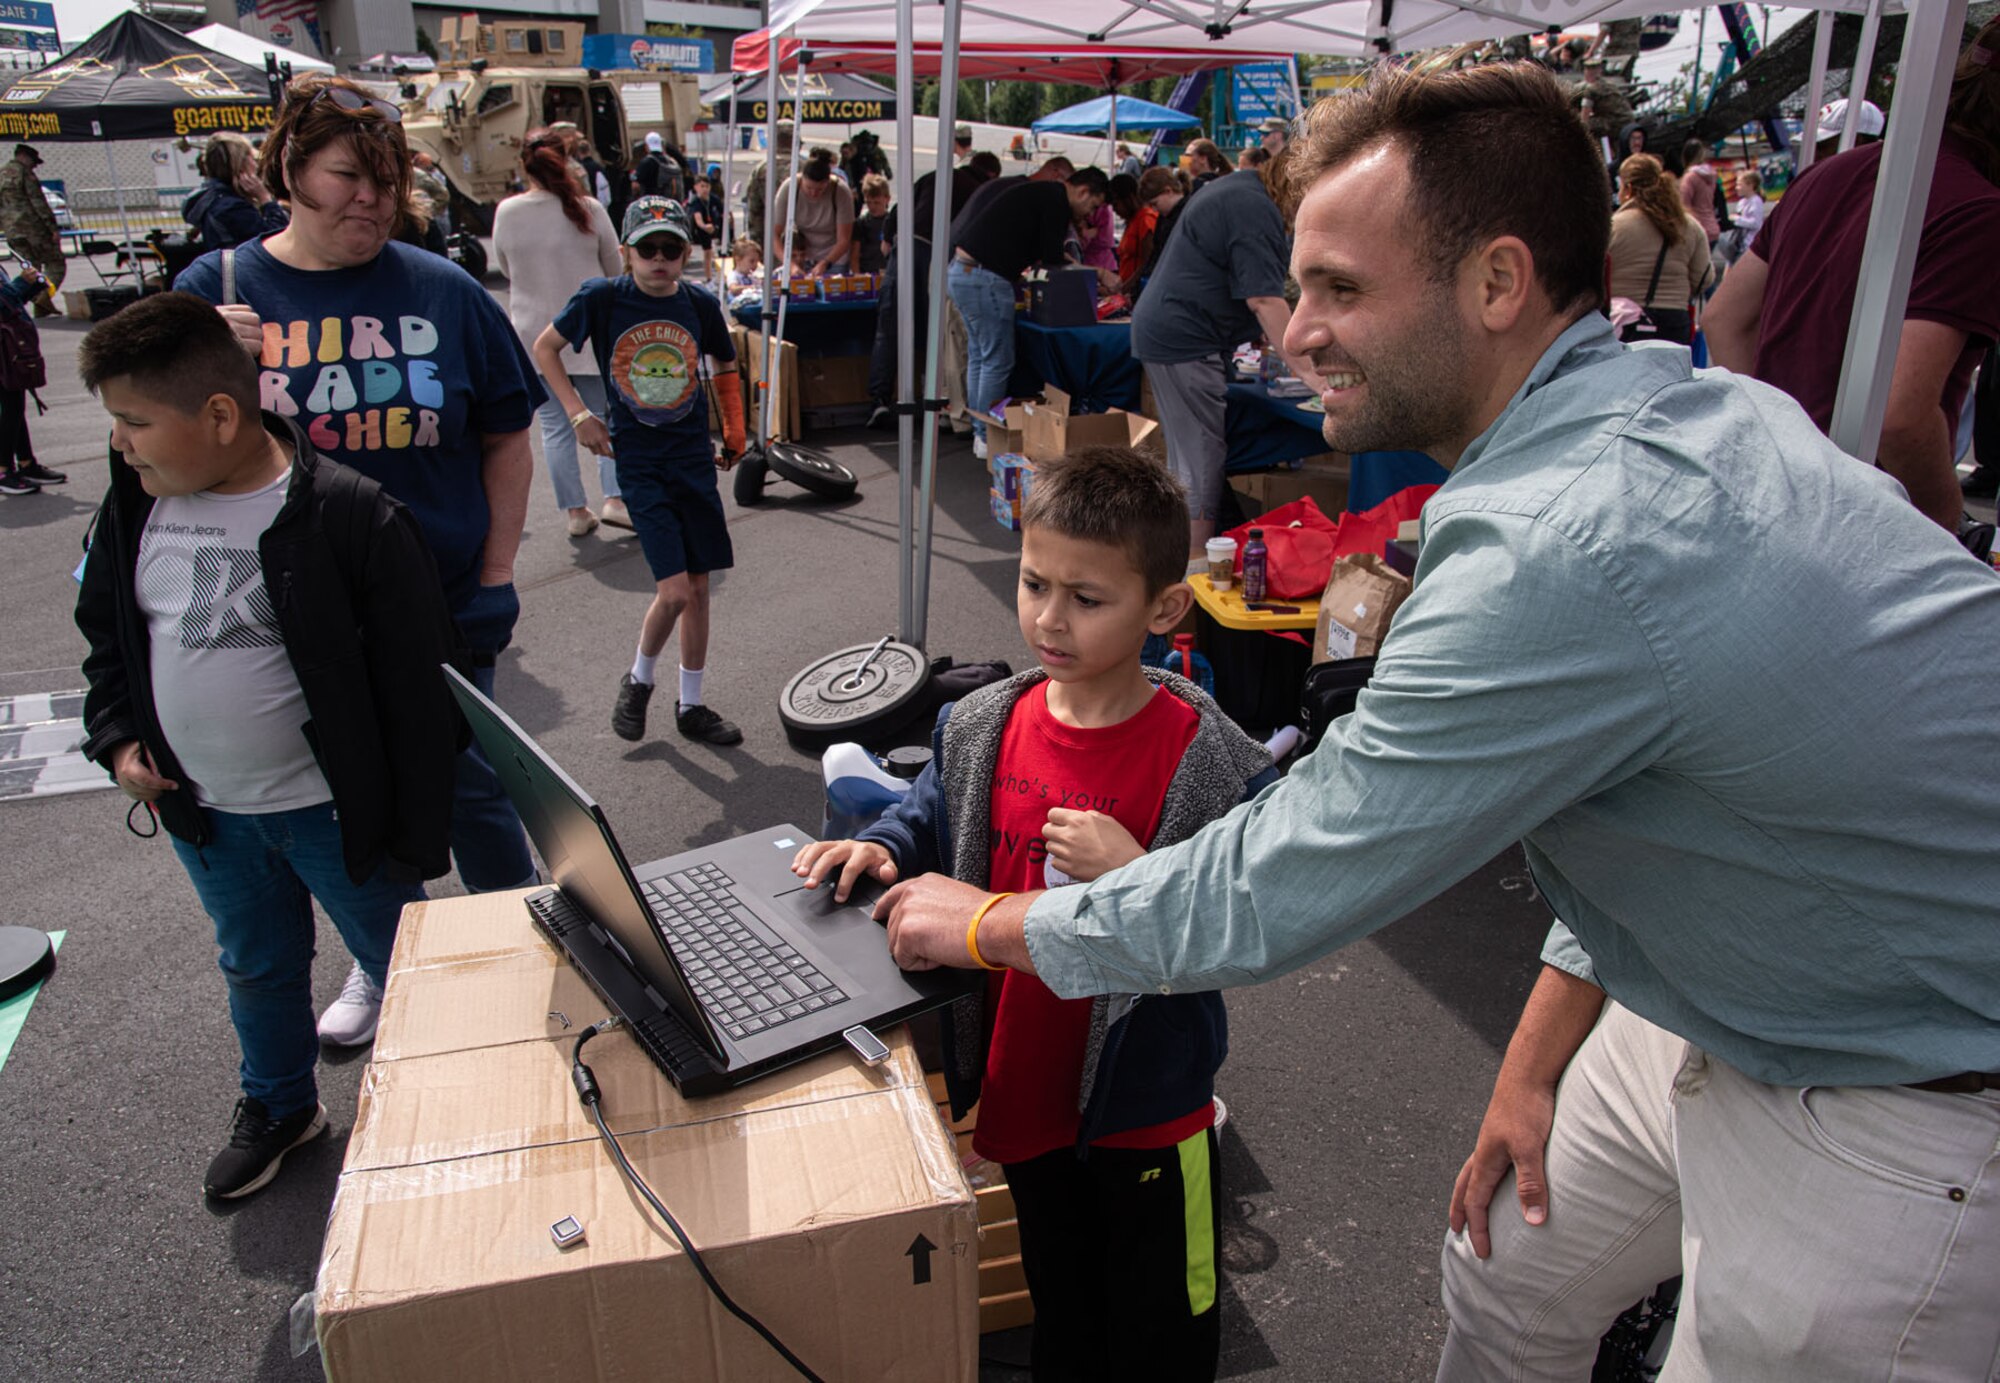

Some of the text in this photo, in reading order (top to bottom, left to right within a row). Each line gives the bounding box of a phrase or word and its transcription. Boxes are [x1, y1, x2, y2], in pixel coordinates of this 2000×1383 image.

[0, 6, 38, 20] GATE 7
[173, 105, 274, 135] goarmy.co
[753, 101, 882, 119] GARMY.COM
[260, 315, 439, 368] HIRD
[630, 326, 689, 346] THE CHILD
[259, 359, 444, 417] RADE
[308, 407, 440, 451] CHER
[147, 522, 227, 536] vin Klein Jeans
[993, 772, 1119, 813] who's your
